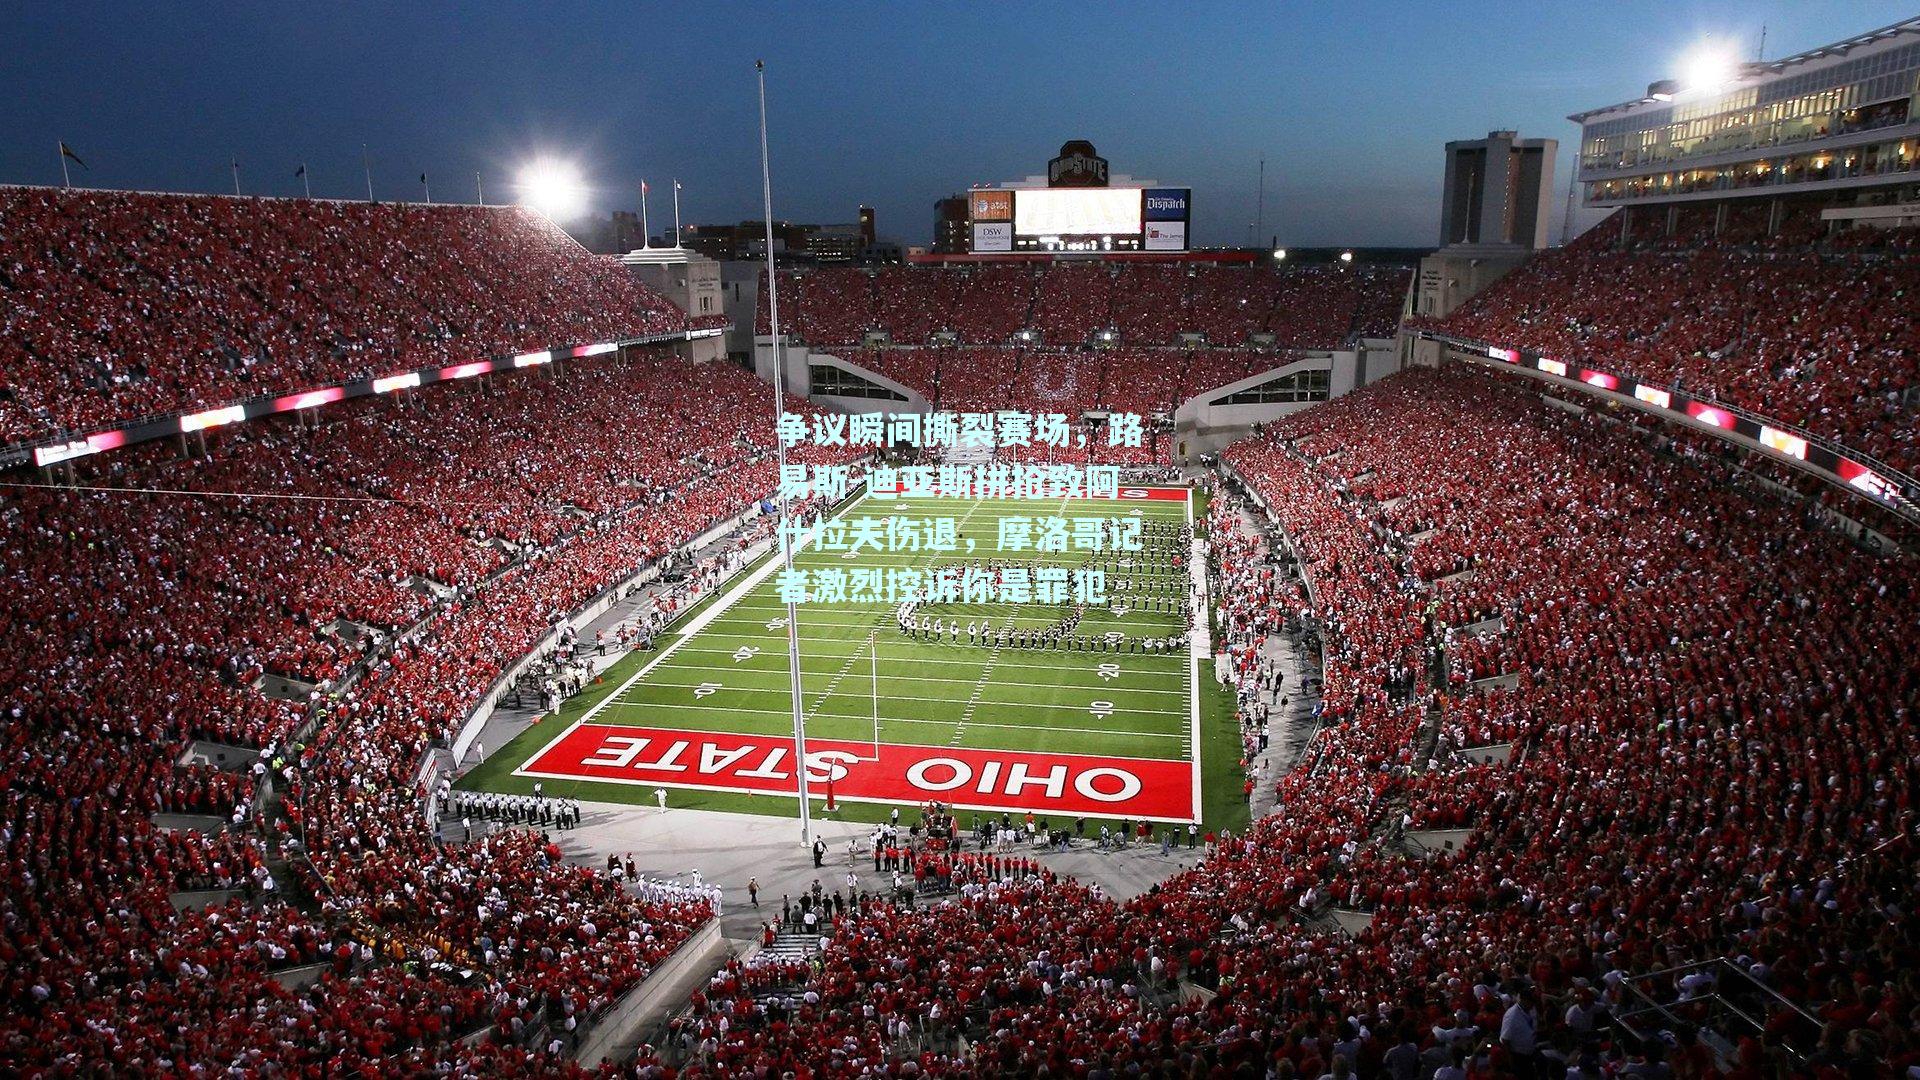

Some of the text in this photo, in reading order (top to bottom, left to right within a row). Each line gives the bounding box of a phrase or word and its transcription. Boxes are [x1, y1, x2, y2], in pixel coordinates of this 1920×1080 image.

[1147, 198, 1186, 211] Dispatch
[983, 228, 1002, 236] DSW
[1097, 663, 1120, 678] 20
[1088, 701, 1114, 715] 10
[580, 736, 1143, 802] OHIO STATE
